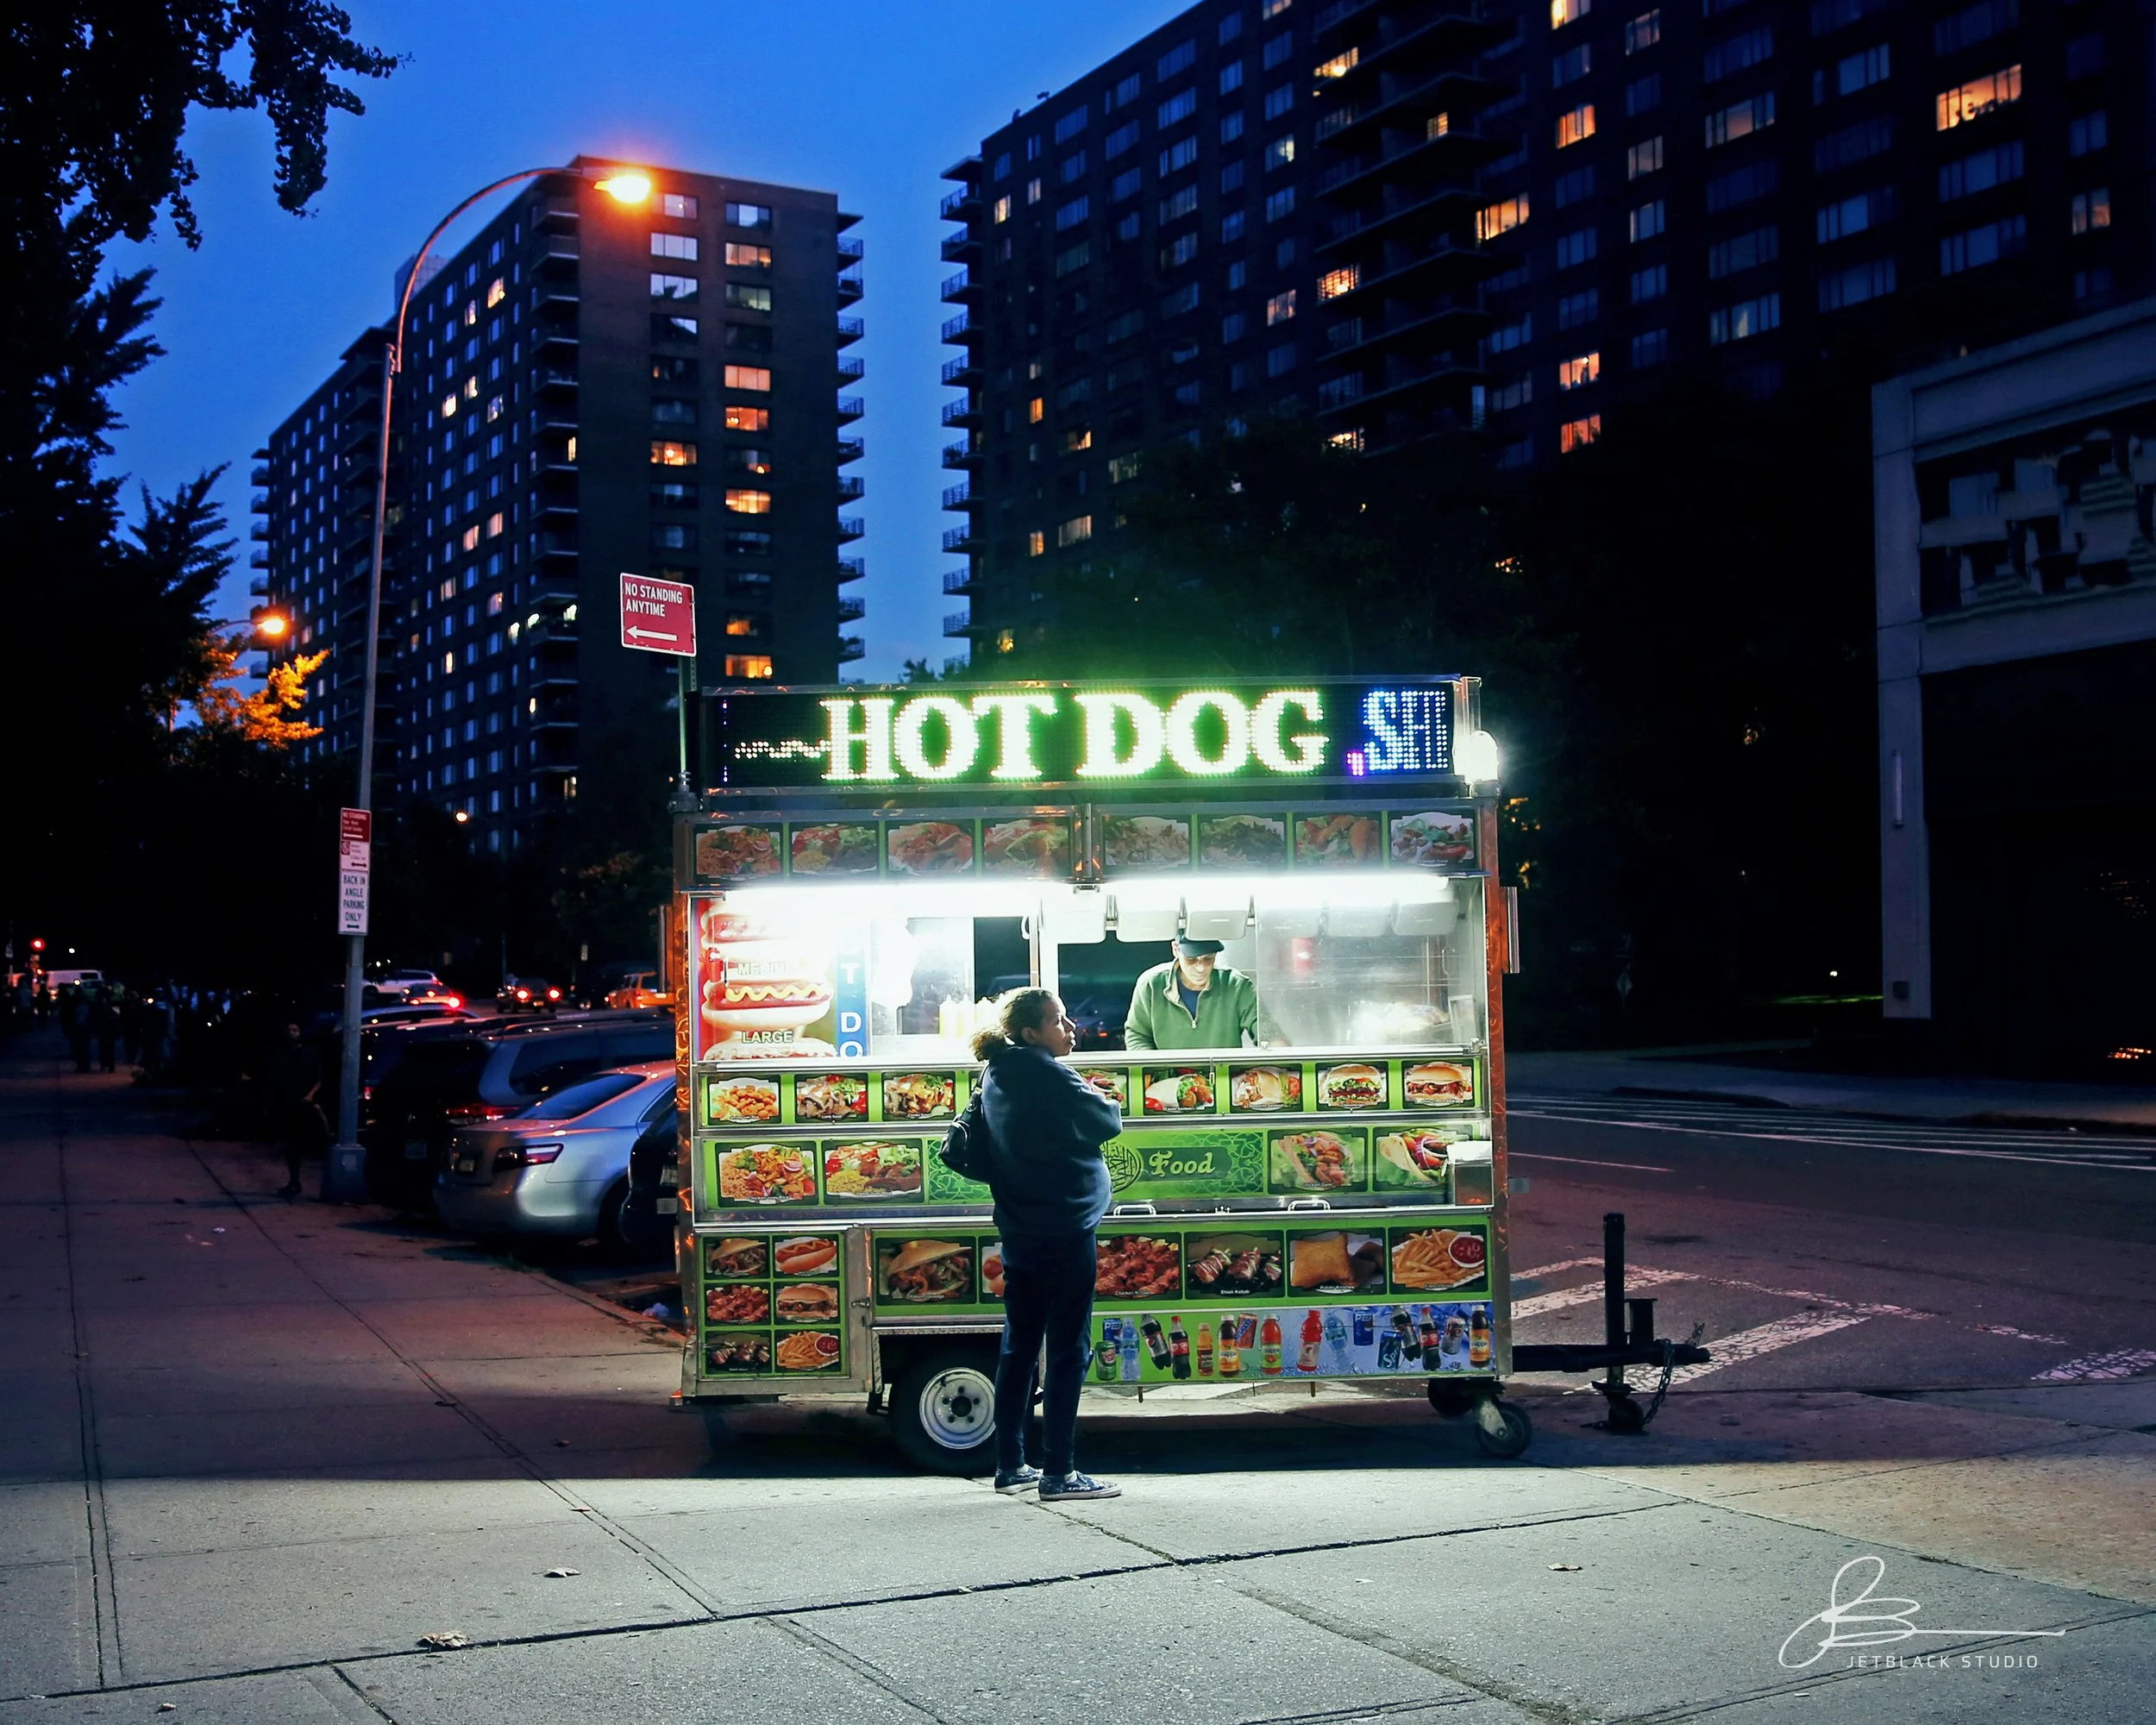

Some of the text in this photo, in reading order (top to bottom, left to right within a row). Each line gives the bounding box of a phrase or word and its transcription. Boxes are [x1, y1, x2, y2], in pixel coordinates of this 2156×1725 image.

[624, 582, 683, 604] NO STANDING
[625, 599, 666, 618] ANYTIME
[819, 696, 1059, 779] HOT
[1074, 691, 1331, 775] DOG
[343, 875, 366, 885] BACK IN
[345, 888, 363, 898] ANGLE
[343, 899, 365, 910] PARKING
[345, 911, 362, 921] ONLY
[737, 962, 798, 976] MEDIU
[741, 1031, 794, 1044] LARGE
[1148, 1151, 1216, 1177] Food
